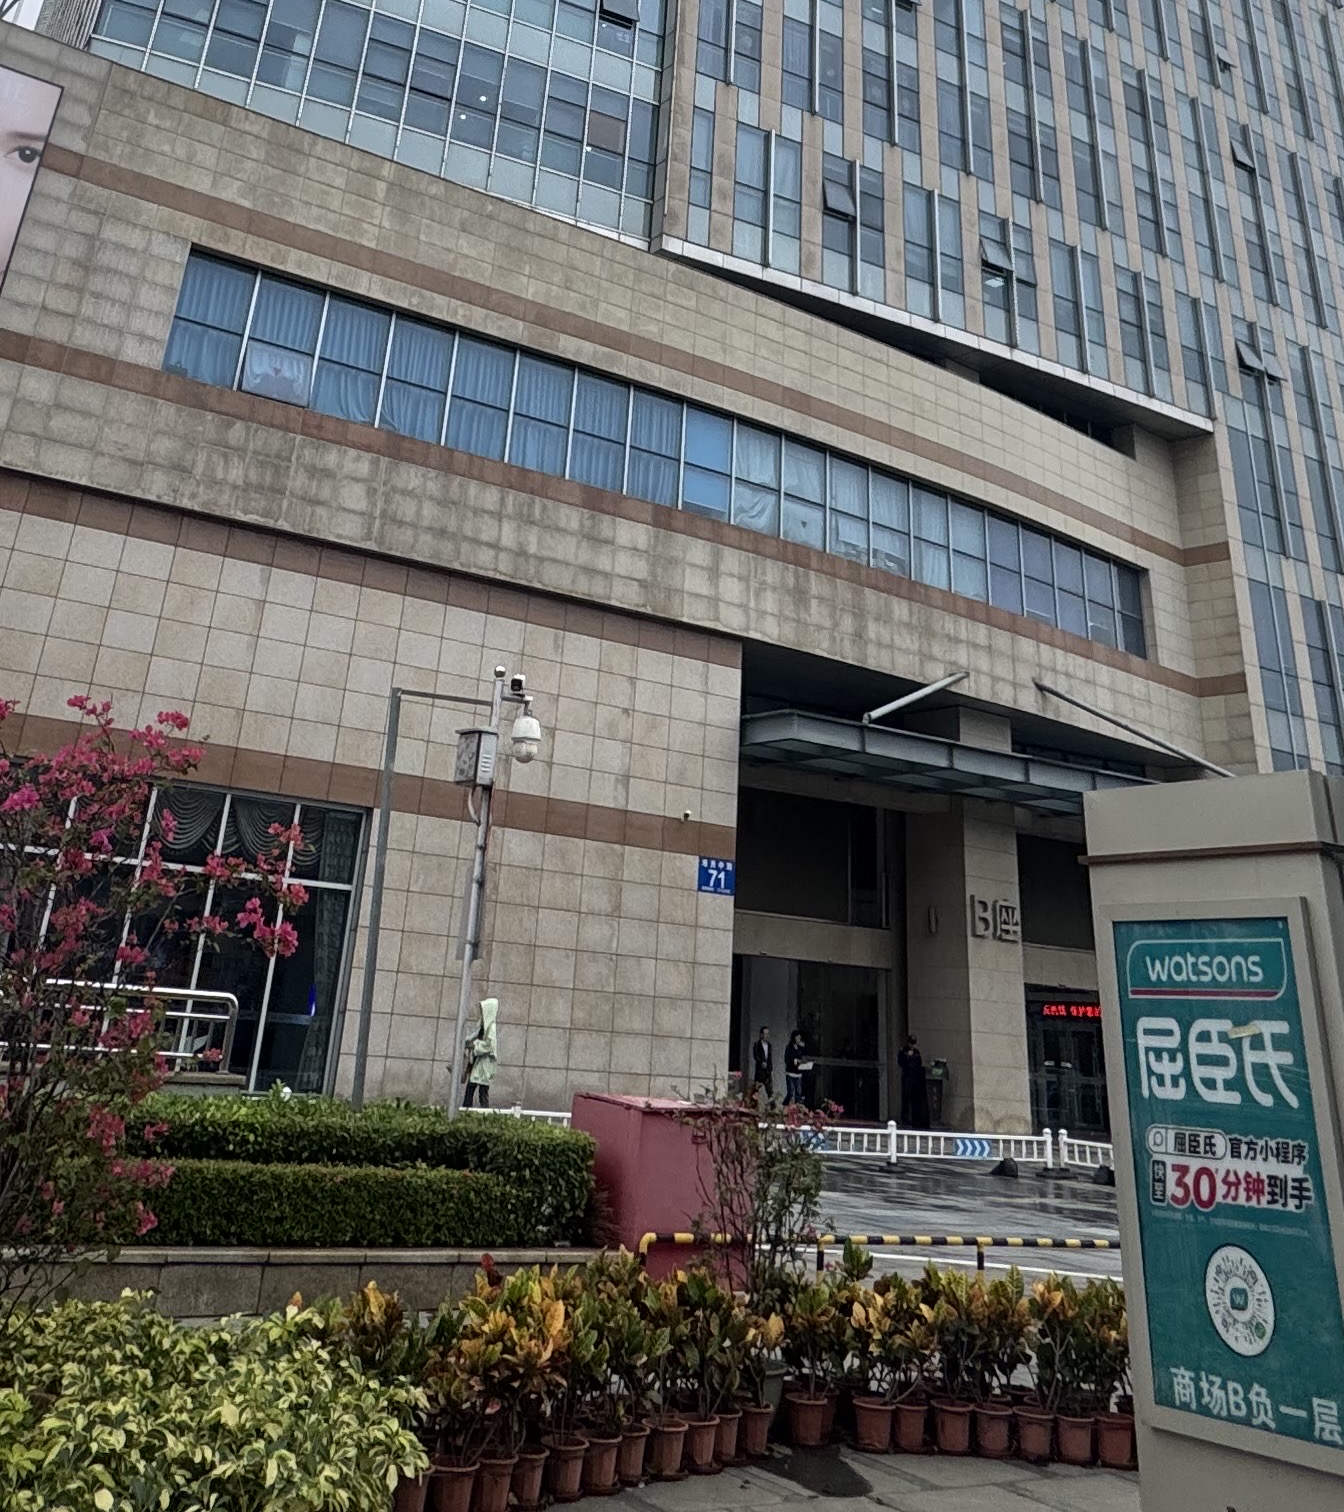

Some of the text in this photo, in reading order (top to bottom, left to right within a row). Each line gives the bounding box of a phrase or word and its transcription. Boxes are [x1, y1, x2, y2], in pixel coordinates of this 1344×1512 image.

[707, 868, 725, 889] 71
[969, 893, 1020, 944] B座
[1145, 952, 1264, 982] watsons
[1136, 1016, 1300, 1109] 屈臣氏
[1173, 1131, 1307, 1166] 屈臣氏 官方小程序
[1153, 1162, 1166, 1201] 快至
[1169, 1365, 1344, 1446] 商场B负一层
